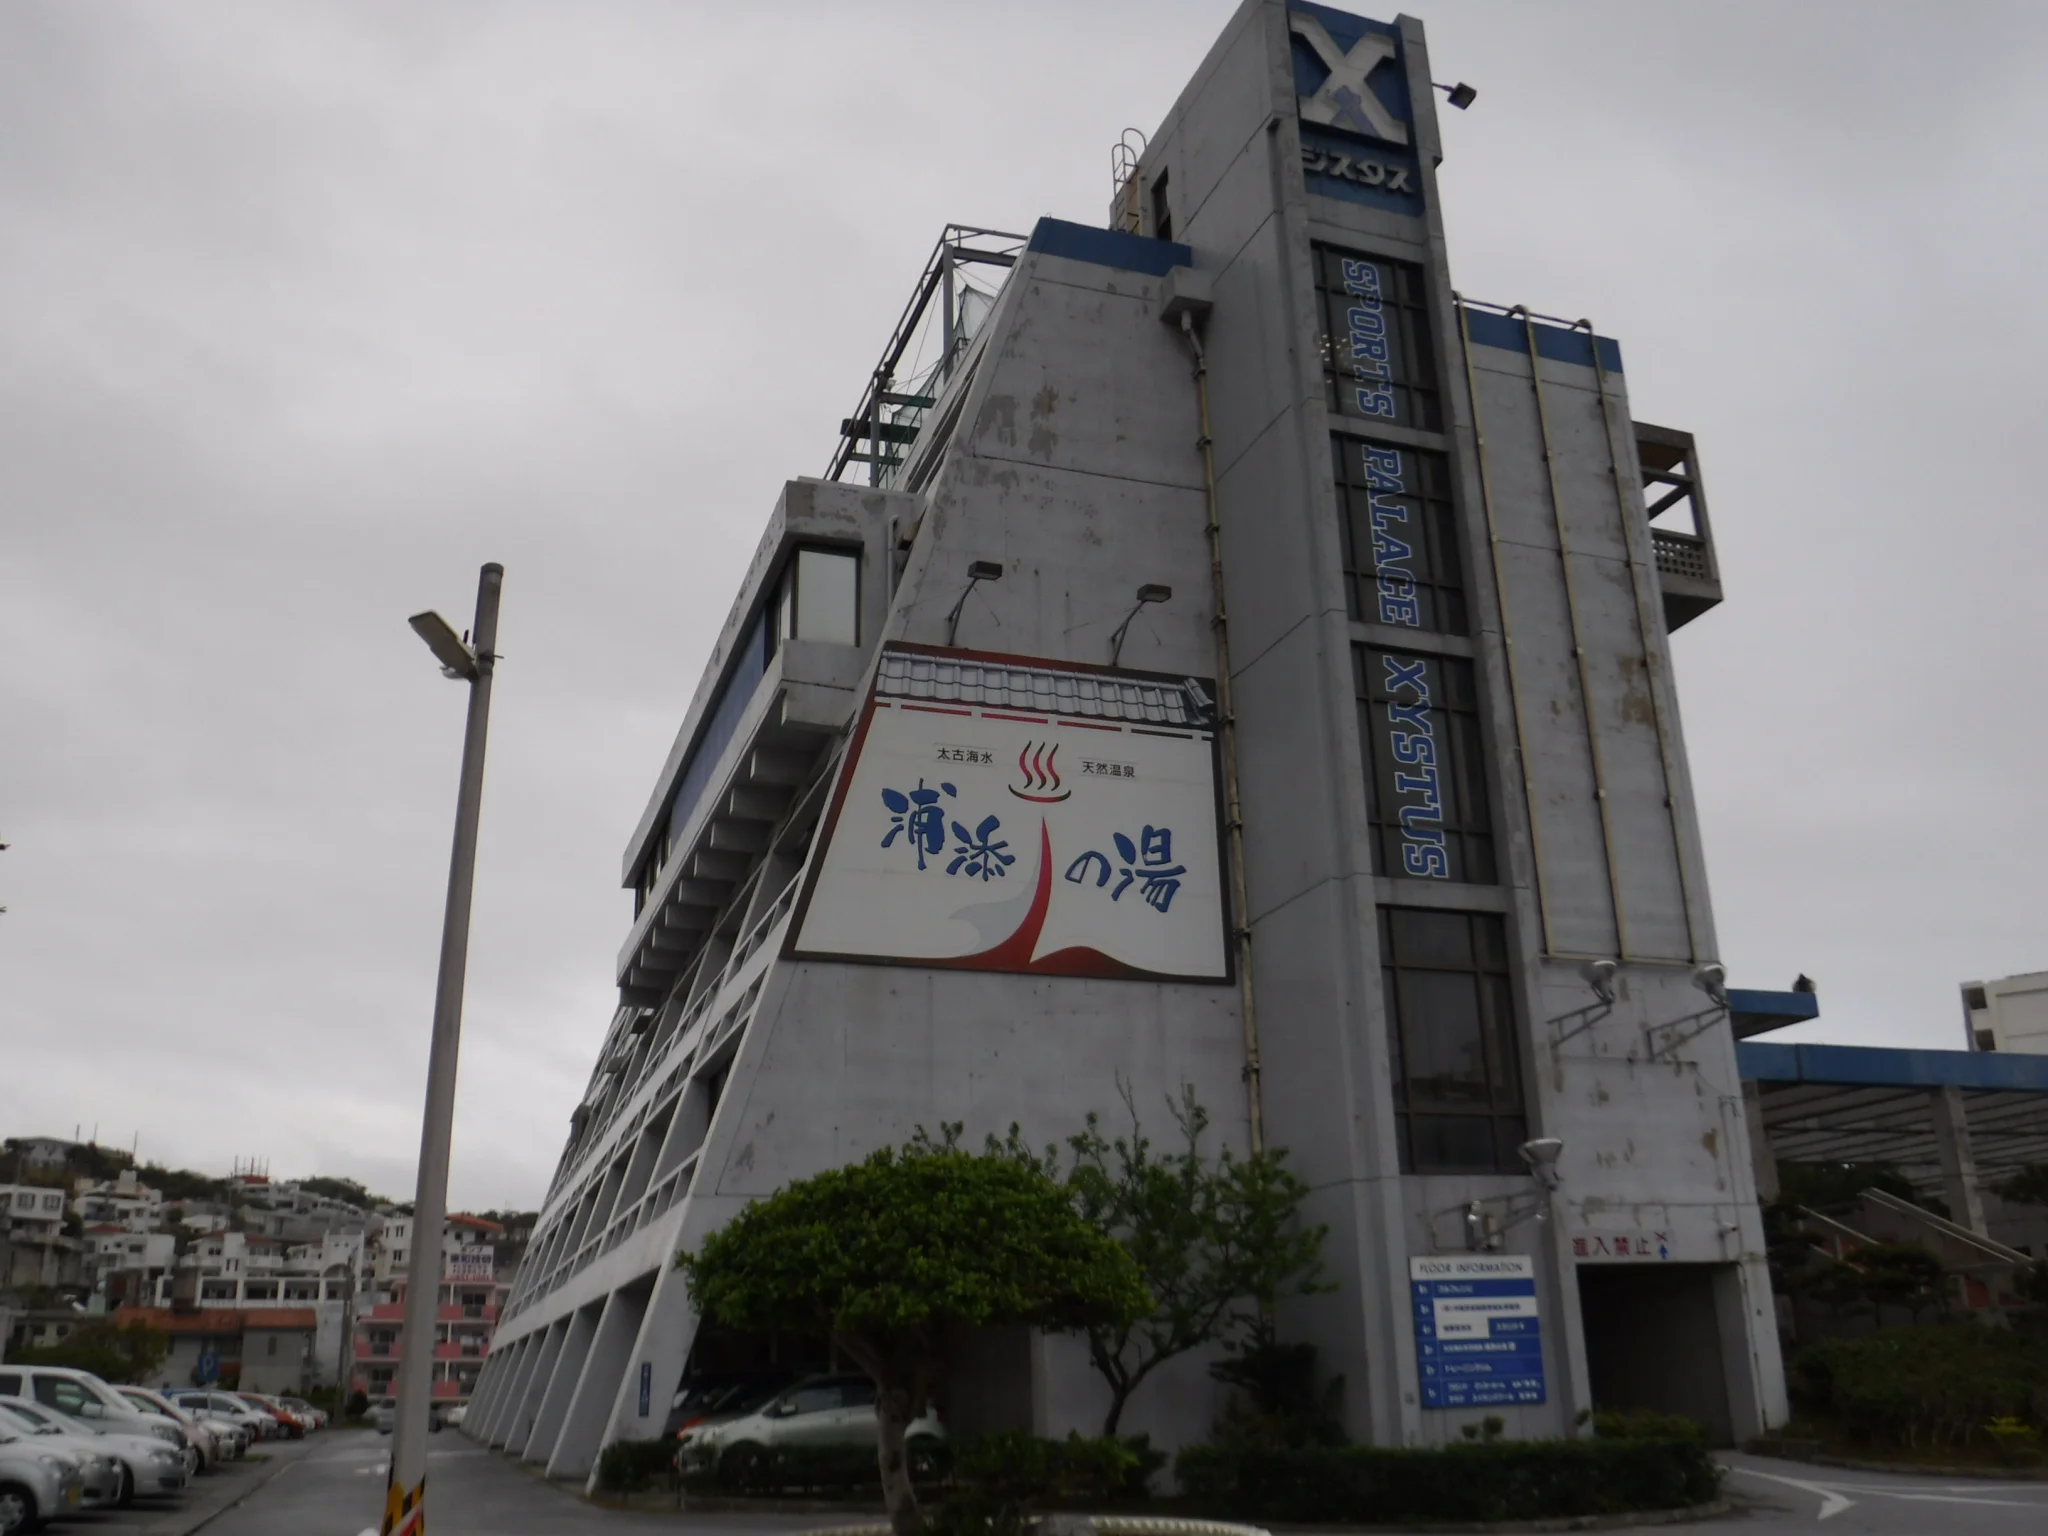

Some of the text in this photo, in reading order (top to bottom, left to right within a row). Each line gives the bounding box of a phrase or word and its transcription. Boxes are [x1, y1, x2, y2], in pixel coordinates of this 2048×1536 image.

[1289, 11, 1408, 145] X
[1342, 258, 1449, 878] SPORTS PALACE XYSTUS
[937, 747, 994, 765] 太古海水
[1082, 760, 1136, 779] 天然温泉
[1420, 1262, 1523, 1274] FLOOR INFORMATION
[203, 1354, 215, 1376] P
